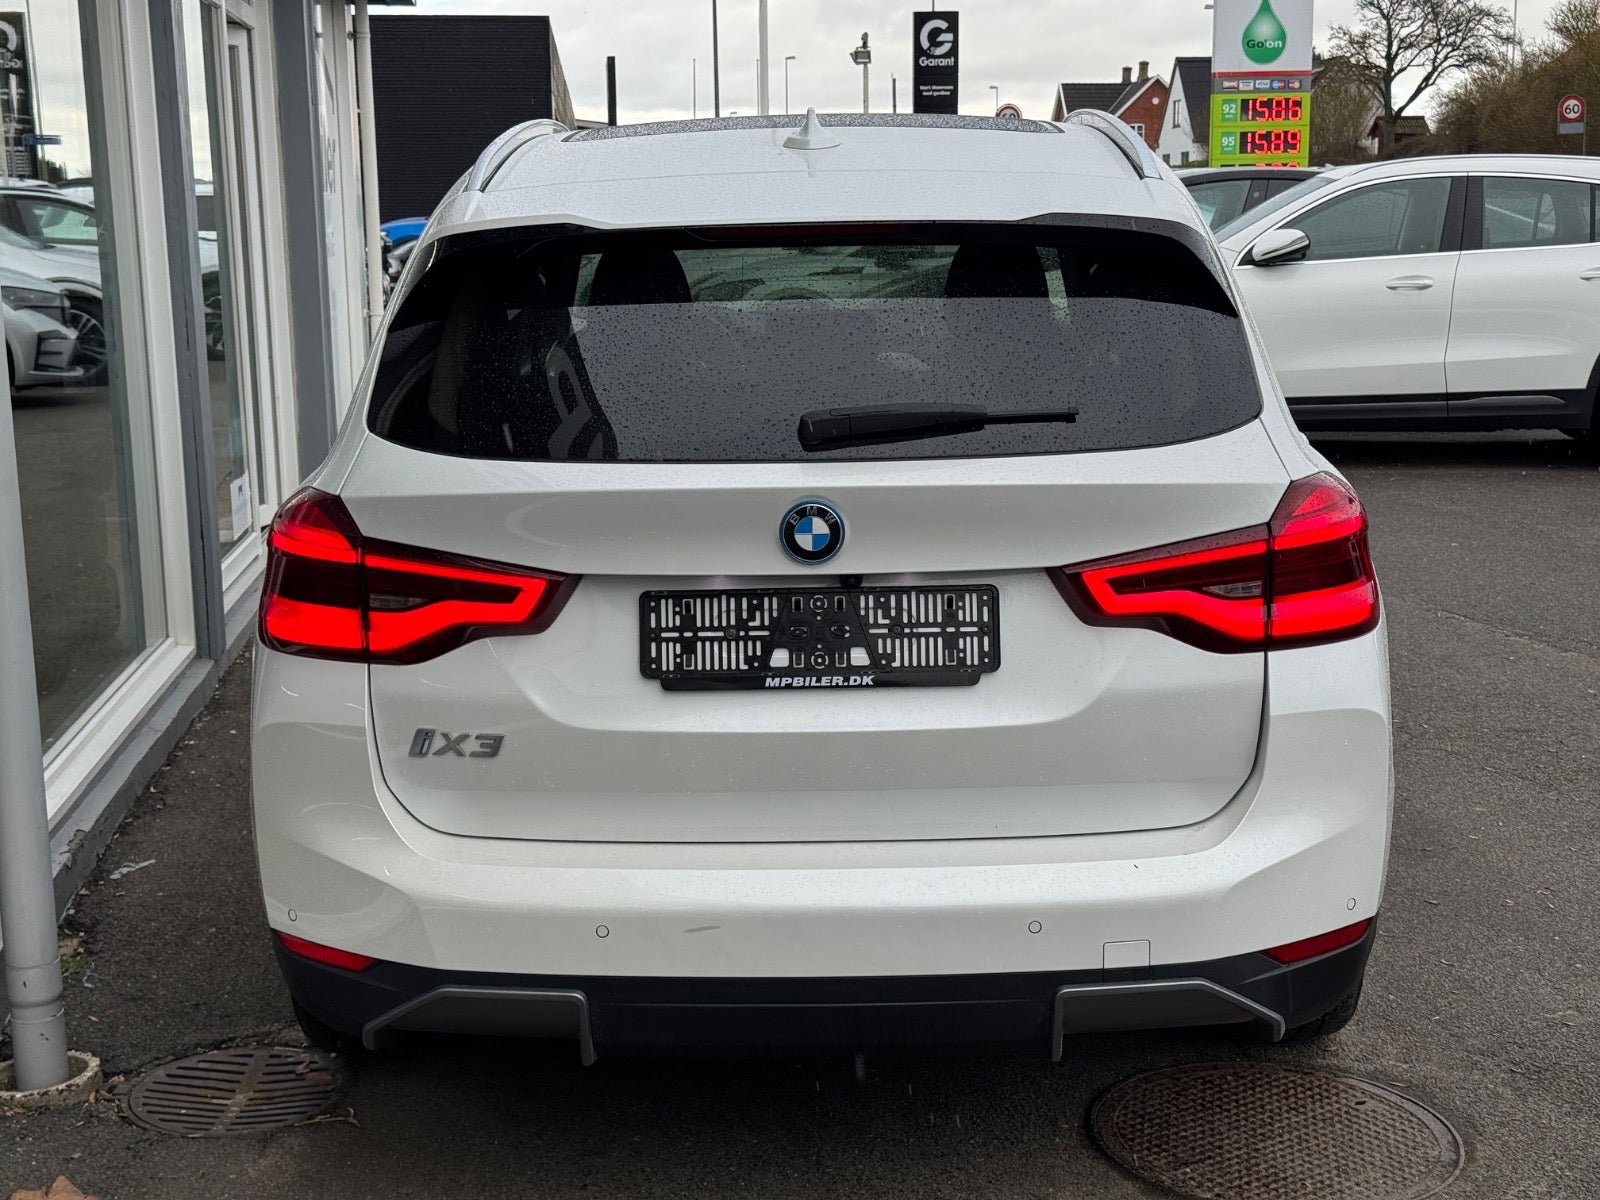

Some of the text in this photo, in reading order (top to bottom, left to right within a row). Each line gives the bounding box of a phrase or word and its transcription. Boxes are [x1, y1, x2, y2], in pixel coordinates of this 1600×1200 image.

[919, 56, 955, 67] Garant
[1223, 97, 1302, 122] 92 15.86
[1565, 104, 1580, 115] 60
[1222, 130, 1301, 154] 95 15.89
[788, 506, 836, 526] BMW
[764, 675, 876, 688] MPBILER.DK
[408, 728, 506, 759] iX3
